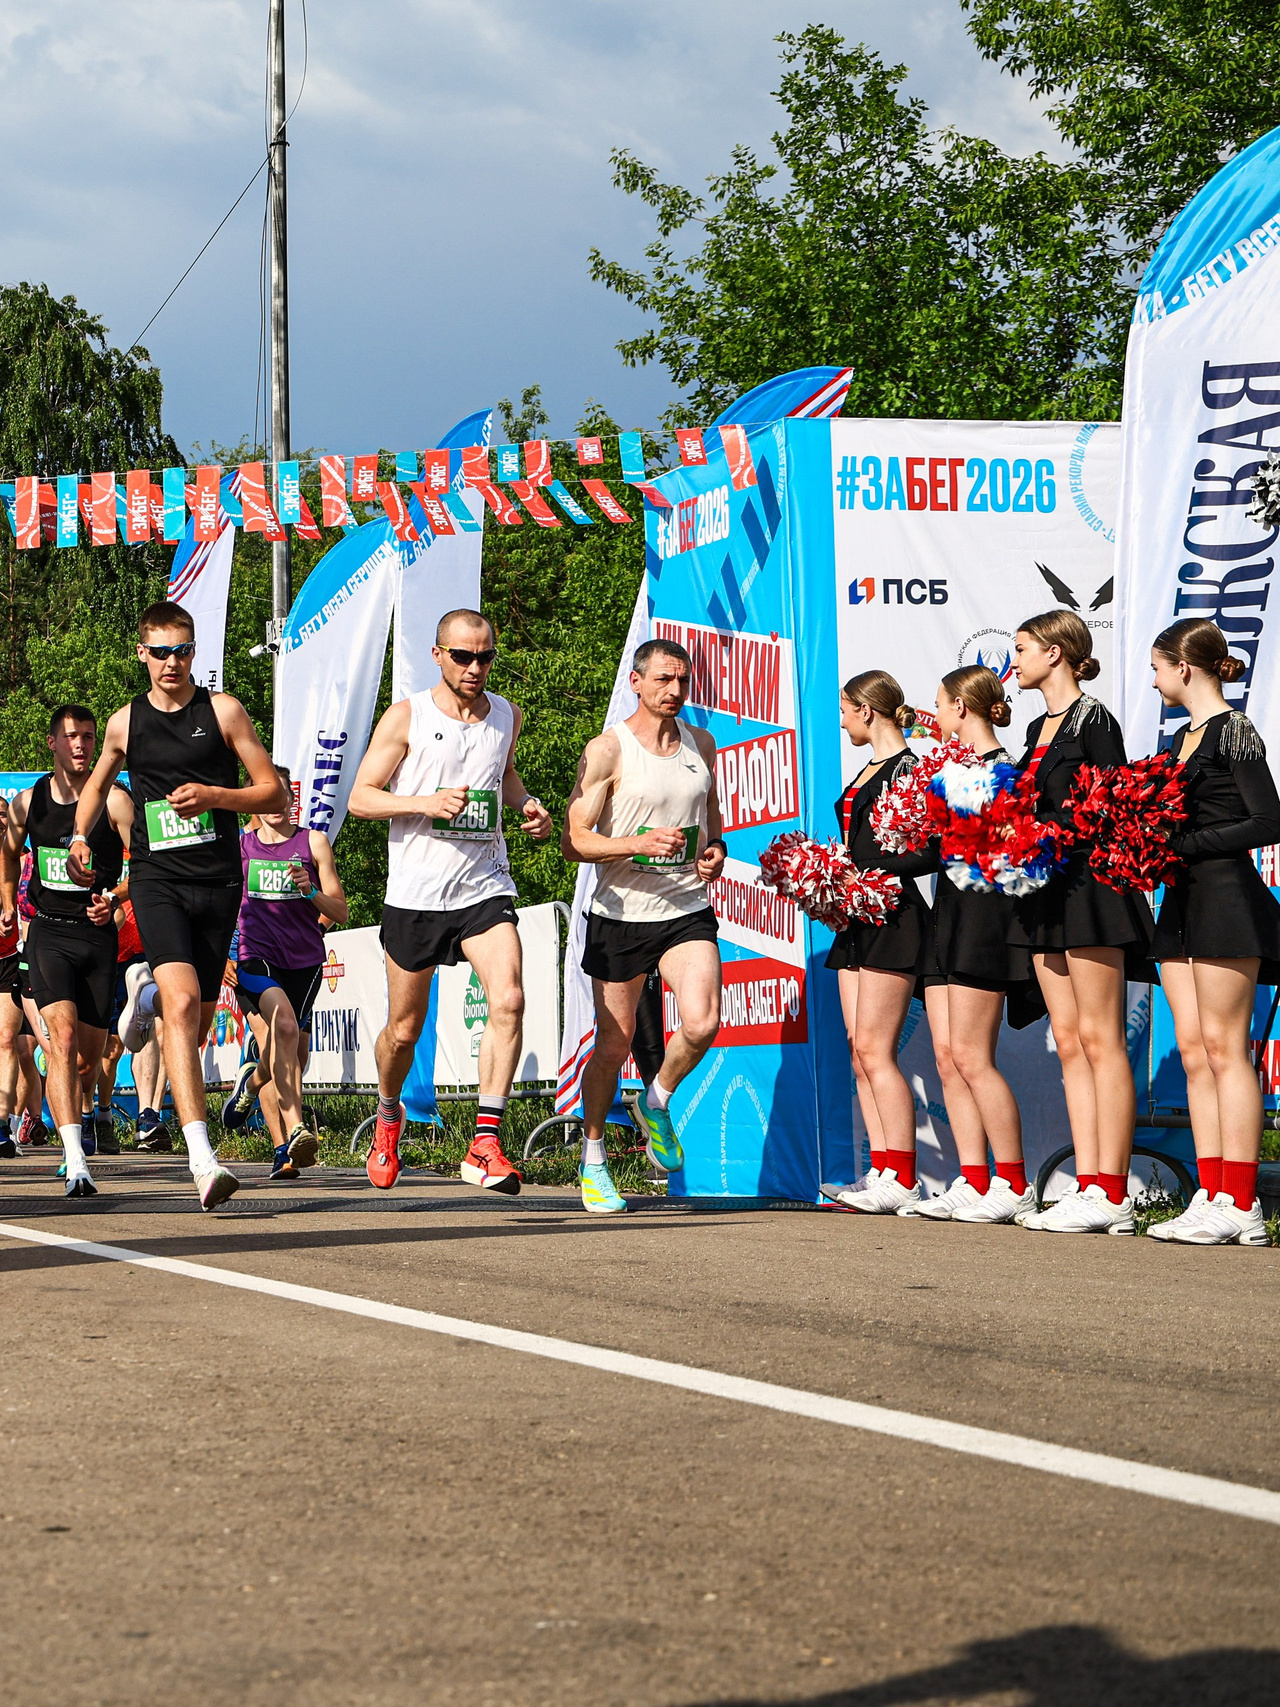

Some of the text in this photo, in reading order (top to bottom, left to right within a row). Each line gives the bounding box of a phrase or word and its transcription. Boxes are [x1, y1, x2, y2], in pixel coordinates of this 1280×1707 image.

[1182, 247, 1240, 300] БЕГУ
[357, 468, 375, 495] ЗАБЕГ
[429, 465, 447, 490] ЗАБЕГ
[502, 450, 518, 474] ЗАБЕГ
[1068, 443, 1086, 493] РЕКОРДЫ
[282, 478, 299, 512] ЗАБЕГ
[836, 455, 1057, 514] #ЗАБЕГ2026
[61, 498, 78, 535] ЗАБЕГ
[130, 494, 148, 531] ЗАБЕГ
[199, 491, 217, 530] ЗАБЕГ
[424, 497, 449, 528] ЗАБЕГ
[1072, 493, 1104, 532] СТАВИМ
[882, 578, 949, 605] ПСБ
[298, 610, 324, 640] БЕГУ
[322, 585, 350, 616] ВСЕМ
[957, 627, 1012, 668] СИЙСКАЯ ФЕДЕРАЦИЯ
[684, 628, 781, 726] ЛИПЕЦКИЙ
[717, 732, 795, 829] АРАФОН
[45, 857, 69, 881] 133
[257, 869, 292, 892] 1262
[708, 877, 795, 944] СЕРОССИЙСКОГО
[464, 998, 489, 1019] bionov
[748, 975, 801, 1025] ЗАБЕГ.РФ
[314, 1008, 360, 1053] ЕРКУЛЕС
